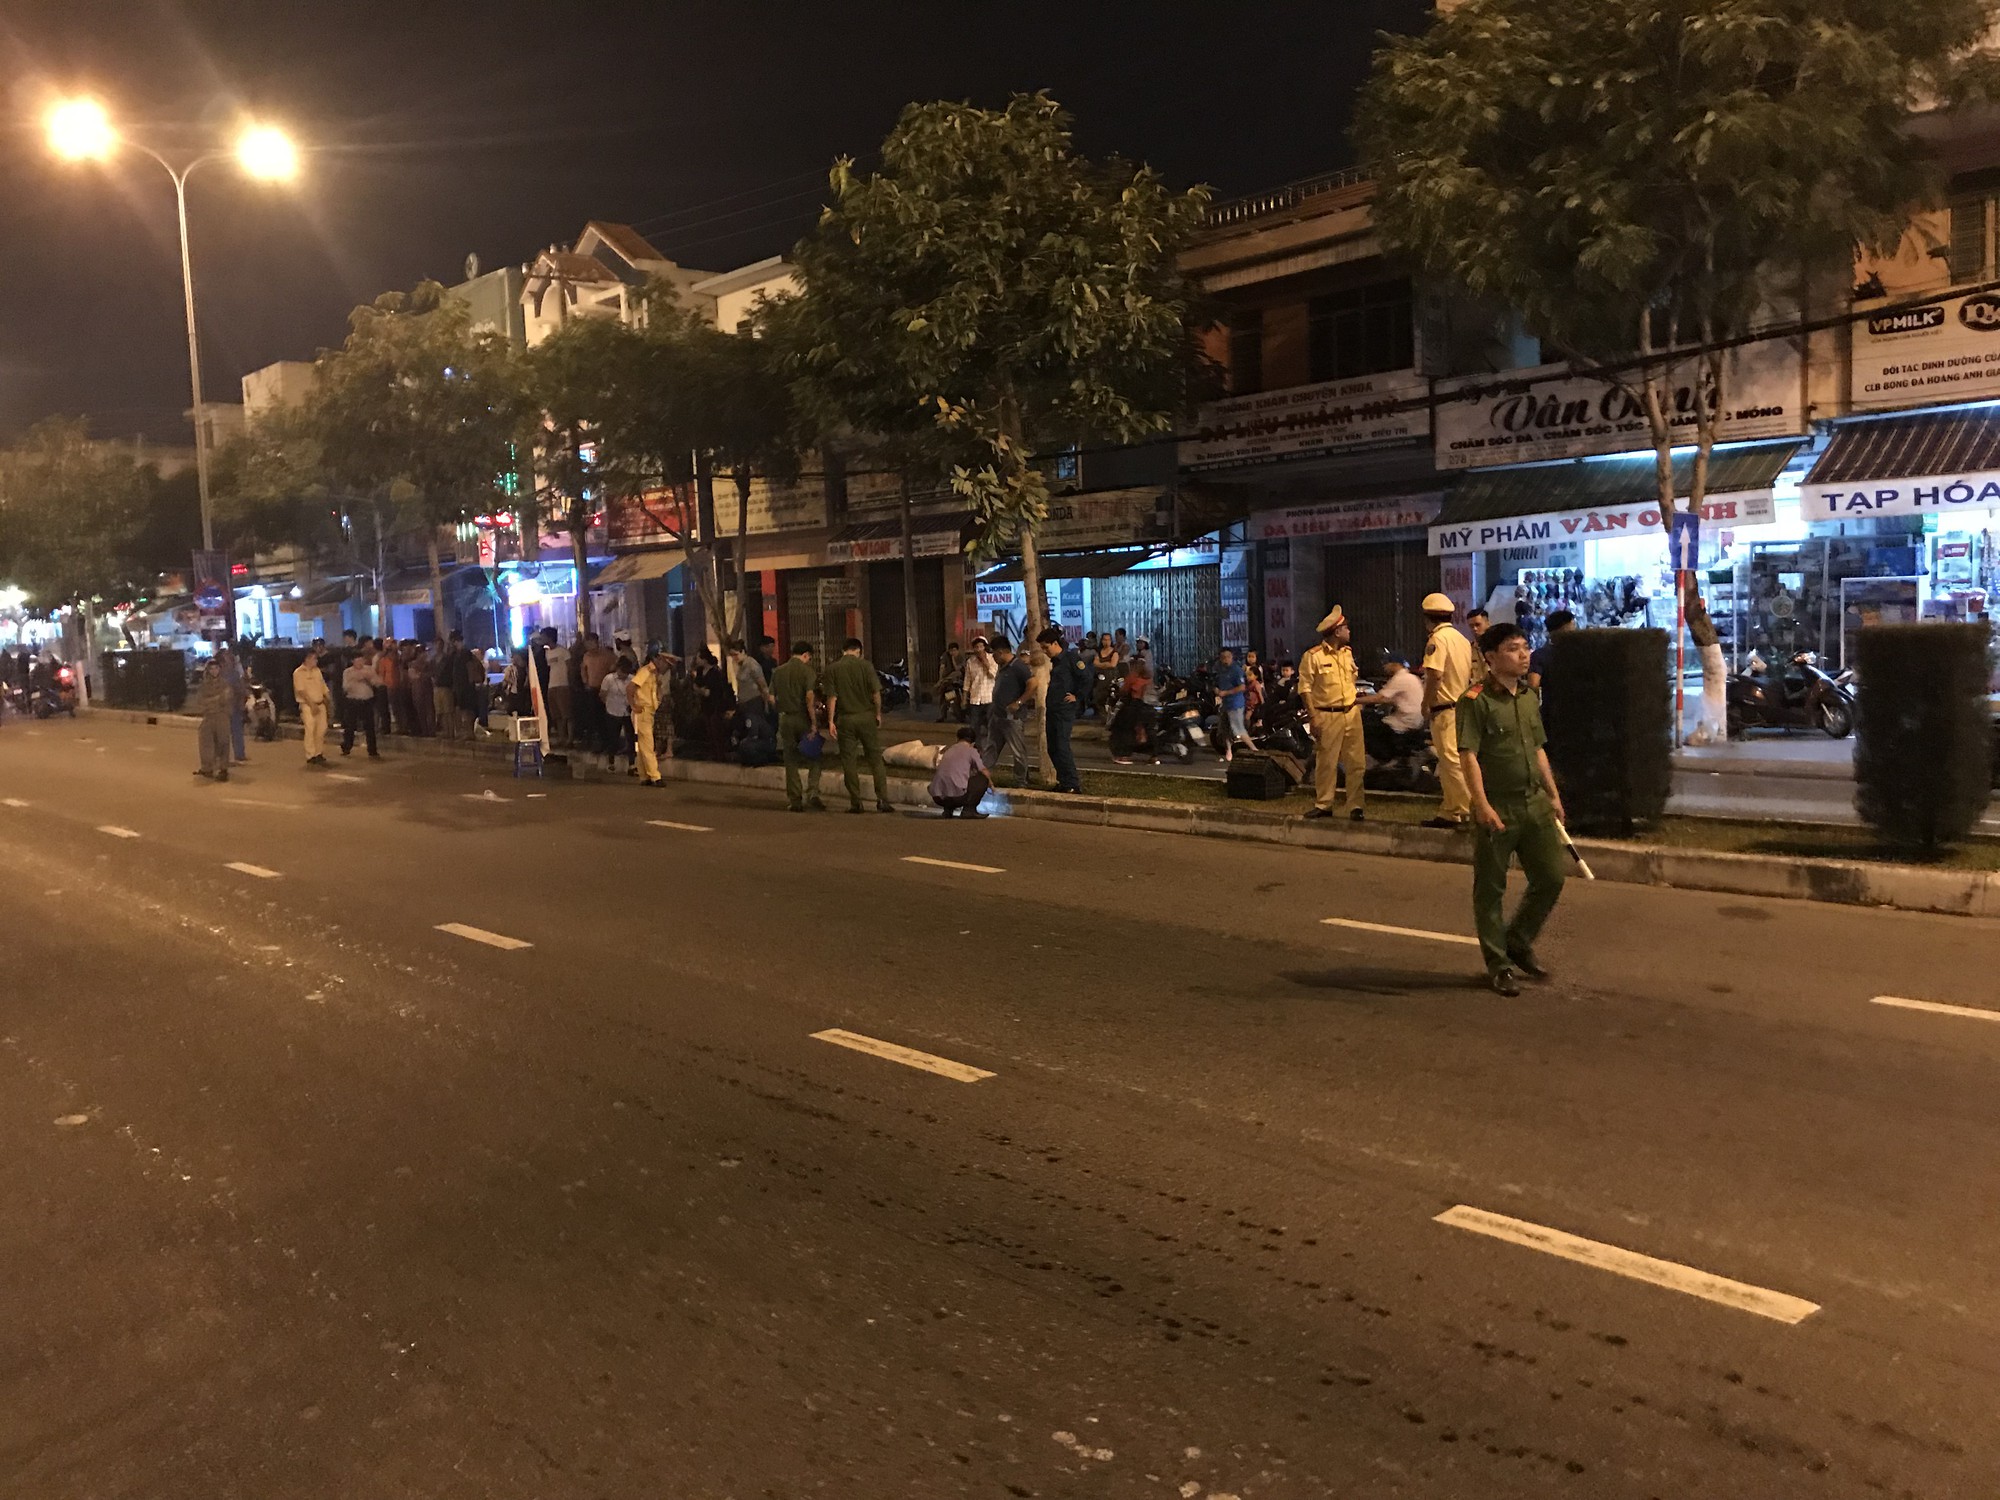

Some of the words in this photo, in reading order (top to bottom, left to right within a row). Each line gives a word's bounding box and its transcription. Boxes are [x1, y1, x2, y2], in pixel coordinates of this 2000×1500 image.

[1872, 312, 1935, 332] VPMILK
[1921, 360, 1945, 371] DINH
[1864, 383, 1881, 392] CLB
[1962, 370, 1983, 380] ANH
[1490, 393, 1593, 432] Vân
[1736, 406, 1783, 420] MÓNG
[1821, 489, 1899, 514] TẠP
[1914, 480, 2000, 506] HÓA
[1046, 505, 1073, 521] ONDA
[1440, 527, 1473, 549] MỸ
[1560, 512, 1629, 534] VÂN
[1638, 502, 1738, 526] OH
[989, 585, 1012, 593] HONDA
[979, 593, 1013, 604] KHANH
[1062, 609, 1081, 618] HONDA
[1229, 603, 1246, 613] ONDA
